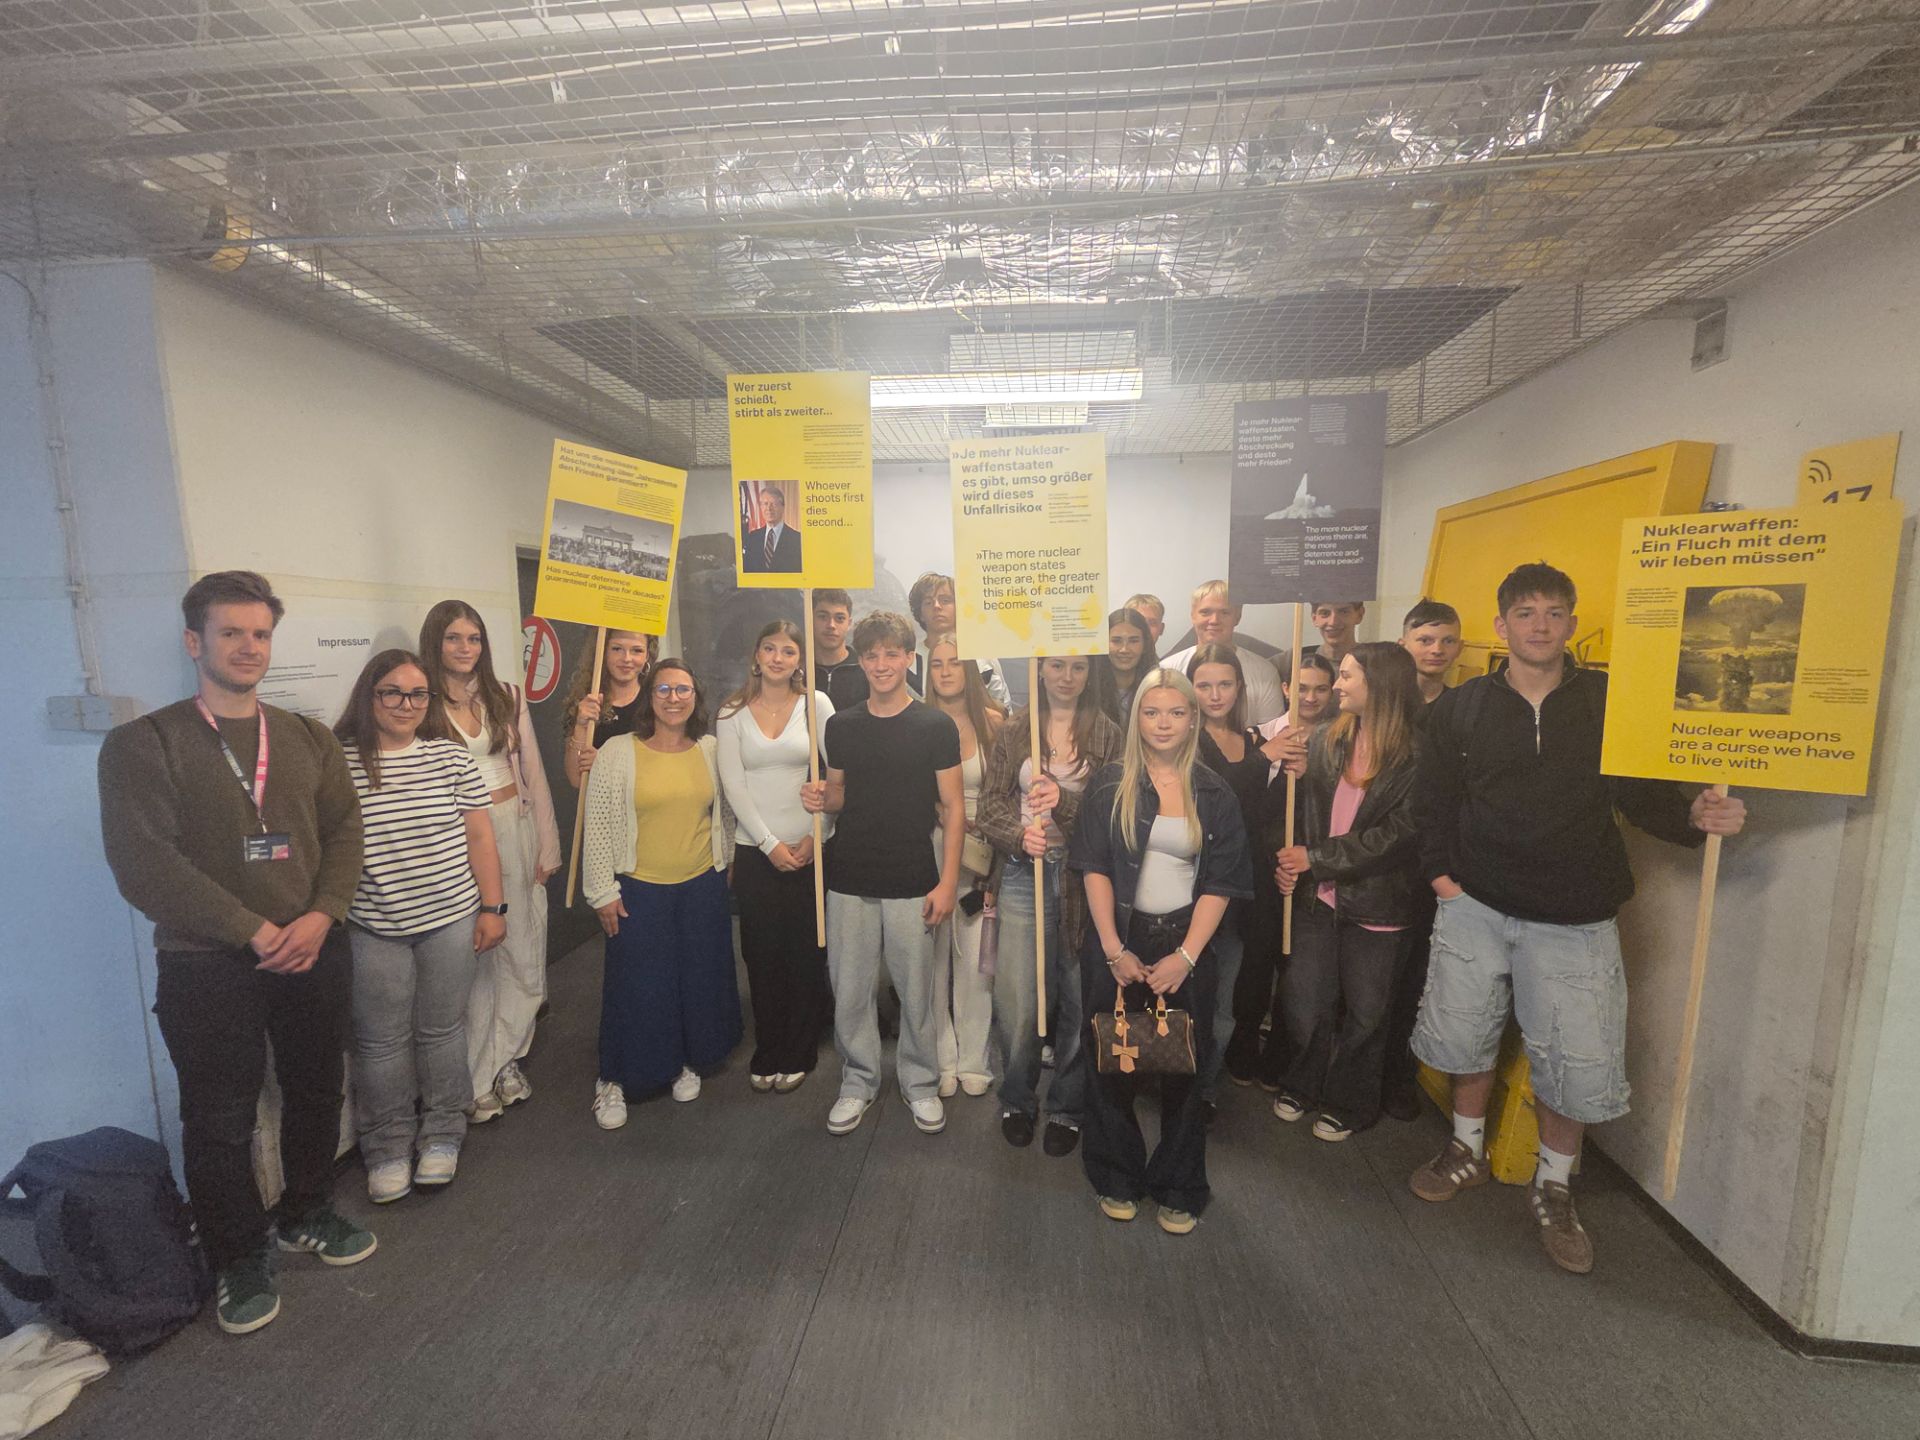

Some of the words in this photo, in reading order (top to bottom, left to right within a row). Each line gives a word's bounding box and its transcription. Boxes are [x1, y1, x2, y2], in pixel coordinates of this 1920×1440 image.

[734, 382, 754, 392] Wer
[758, 382, 792, 391] zuerst
[735, 395, 777, 405] schießt,
[735, 408, 764, 417] stirbt
[767, 407, 781, 417] als
[784, 407, 832, 416] zweiter...
[1262, 434, 1282, 442] mehr
[952, 448, 975, 459] »Je
[979, 447, 1010, 457] mehr
[1015, 445, 1070, 456] Nuklear-
[1239, 442, 1294, 450] Abschreckung
[1238, 451, 1253, 459] und
[962, 460, 1053, 472] waffenstaaten
[1238, 460, 1257, 468] mehr
[805, 481, 851, 490] Whoever
[962, 477, 976, 487] es
[980, 475, 1008, 489] gibt,
[1013, 475, 1046, 486] umso
[1050, 472, 1093, 485] größer
[806, 494, 840, 503] shoots
[843, 493, 864, 502] first
[963, 491, 989, 501] wird
[993, 489, 1034, 499] dieses
[806, 506, 827, 515] dies
[963, 503, 1042, 516] Unfallrisiko«
[807, 518, 853, 527] second...
[1340, 524, 1368, 532] nuclear
[1643, 519, 1798, 537] Nuklearwaffen:
[1632, 537, 1670, 555] „Ein
[1677, 536, 1732, 552] Fluch
[1738, 534, 1772, 550] mit
[1778, 532, 1826, 547] dem
[977, 550, 1002, 560] »The
[1006, 548, 1035, 559] more
[1038, 547, 1080, 557] nuclear
[1640, 554, 1668, 568] wir
[1673, 552, 1727, 567] leben
[982, 561, 1027, 573] weapon
[1030, 560, 1065, 570] states
[546, 566, 561, 574] Has
[563, 569, 590, 580] nuclear
[592, 574, 630, 586] deterrence
[983, 576, 1011, 585] there
[1015, 575, 1035, 585] are,
[1038, 573, 1056, 583] the
[1059, 572, 1100, 584] greater
[545, 575, 587, 588] guaranteed
[599, 583, 619, 594] peace
[632, 589, 664, 600] decades?
[983, 587, 1004, 597] this
[1007, 586, 1027, 596] risk
[1030, 585, 1042, 595] of
[1044, 583, 1094, 595] accident
[984, 600, 1043, 610] becomes«
[318, 638, 370, 648] Impressum
[1672, 723, 1743, 737] Nuclear
[1748, 728, 1841, 743] weapons
[1670, 738, 1697, 750] are
[1702, 740, 1712, 751] a
[1718, 740, 1770, 755] curse
[1773, 743, 1802, 755] we
[1806, 746, 1855, 761] have
[1669, 753, 1686, 764] to
[1691, 753, 1723, 767] live
[1728, 756, 1768, 770] with
